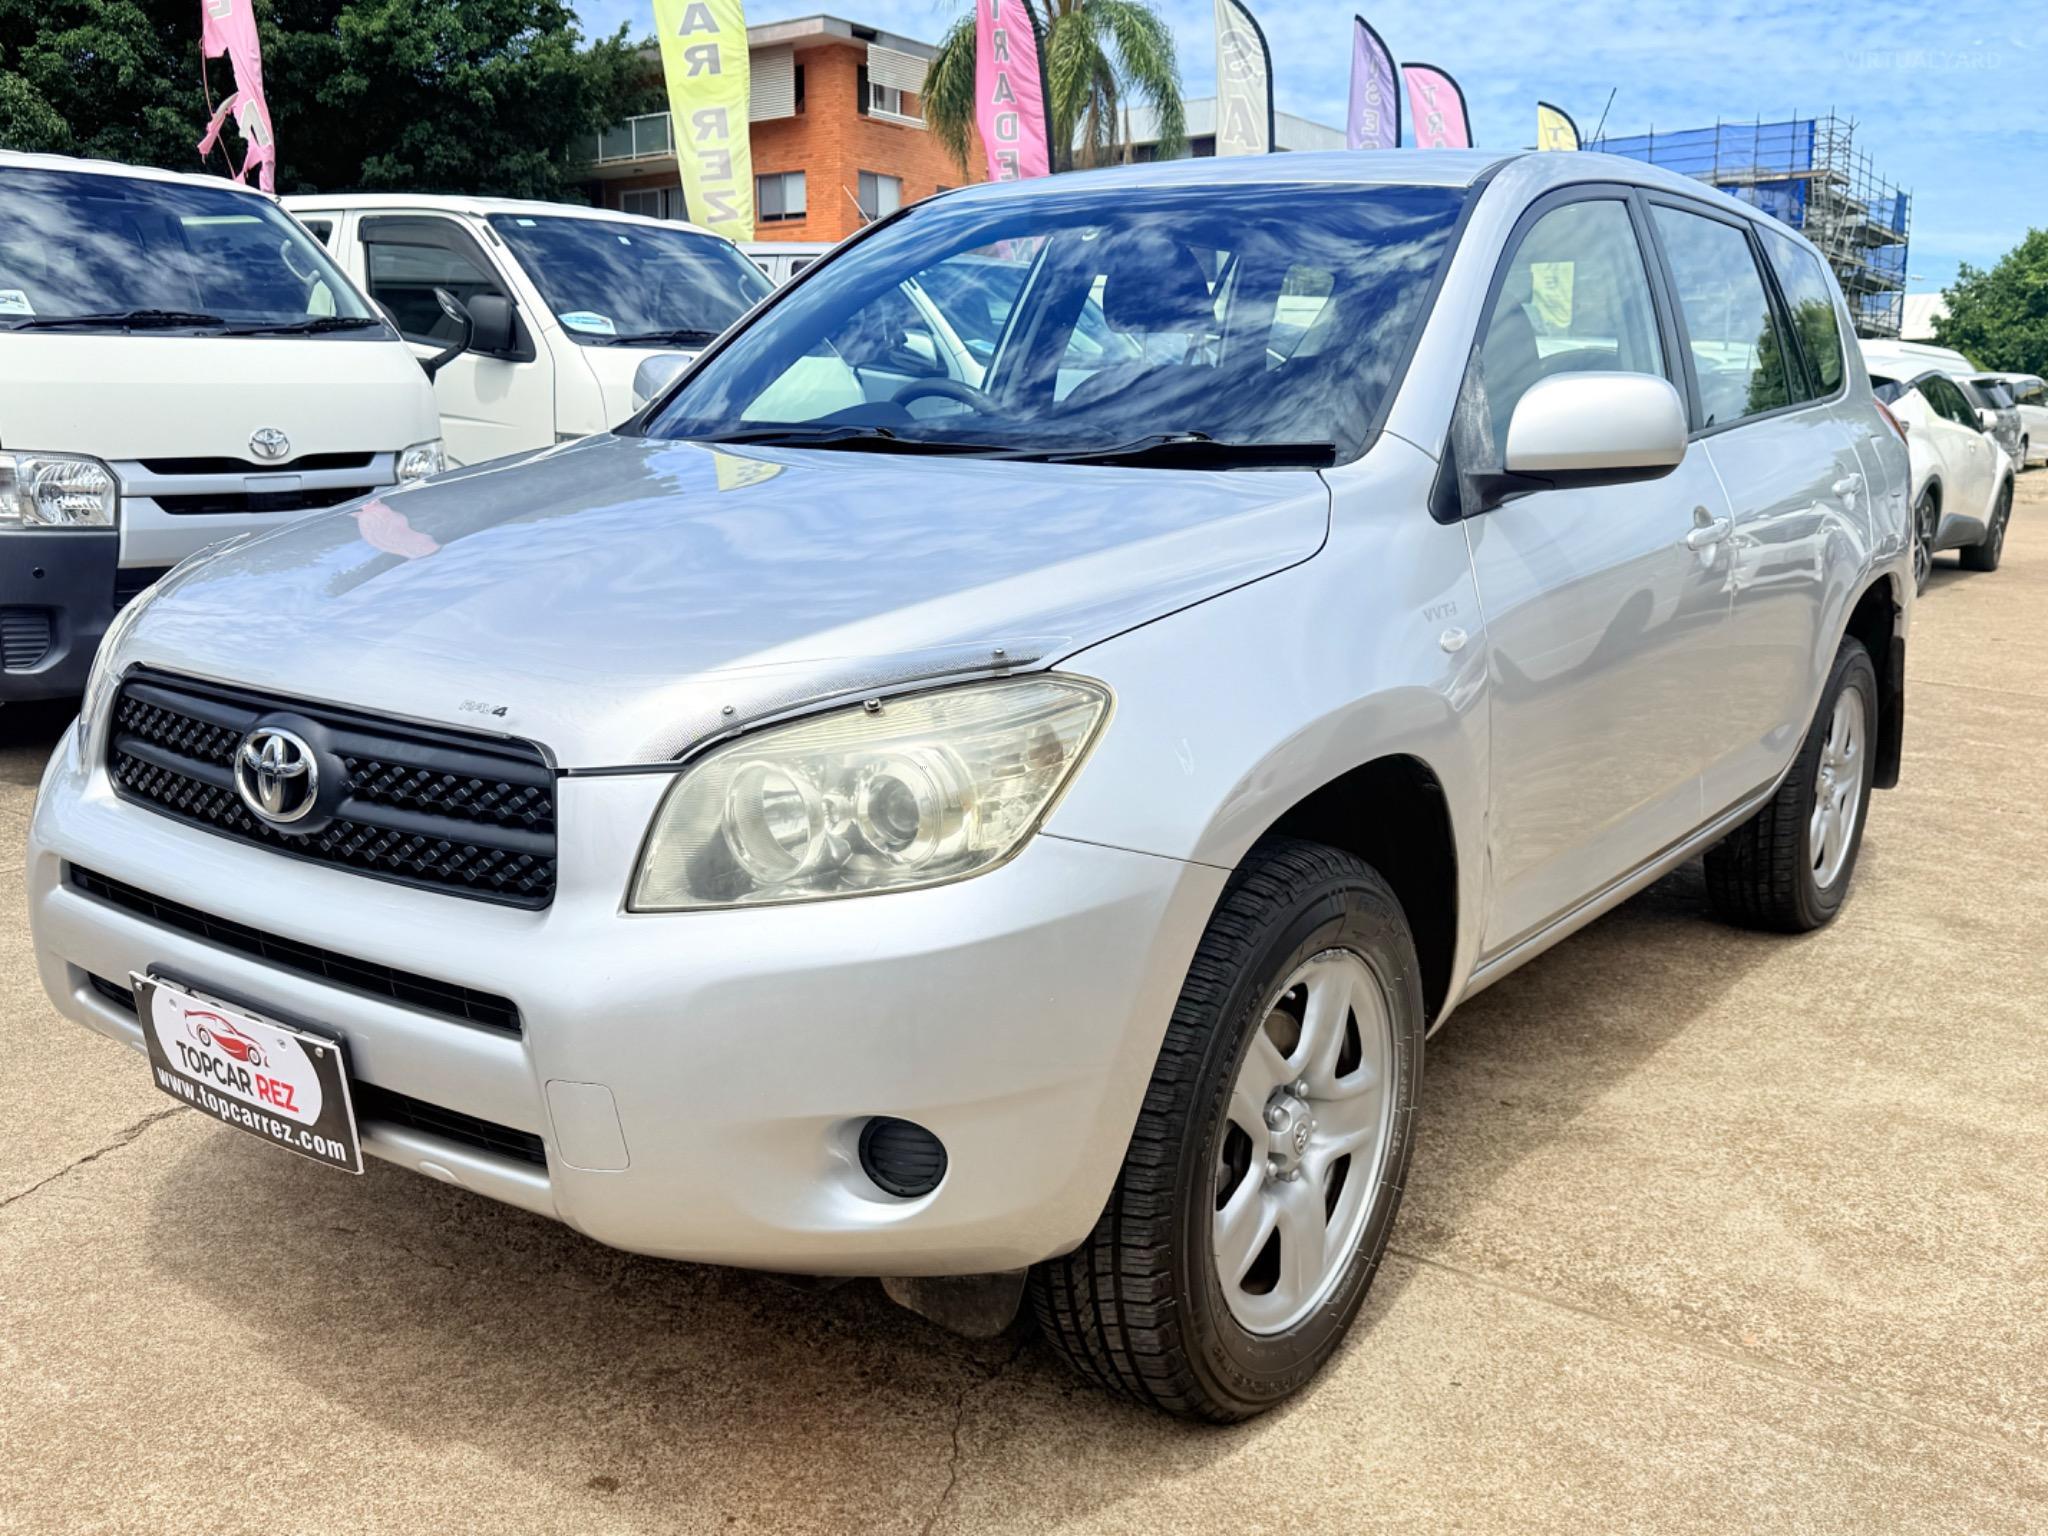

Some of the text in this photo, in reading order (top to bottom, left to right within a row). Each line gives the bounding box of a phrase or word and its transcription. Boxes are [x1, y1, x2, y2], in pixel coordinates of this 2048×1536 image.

[156, 1066, 347, 1161] www.topcarrez.com
[176, 1040, 299, 1113] TOPCAR REZ
